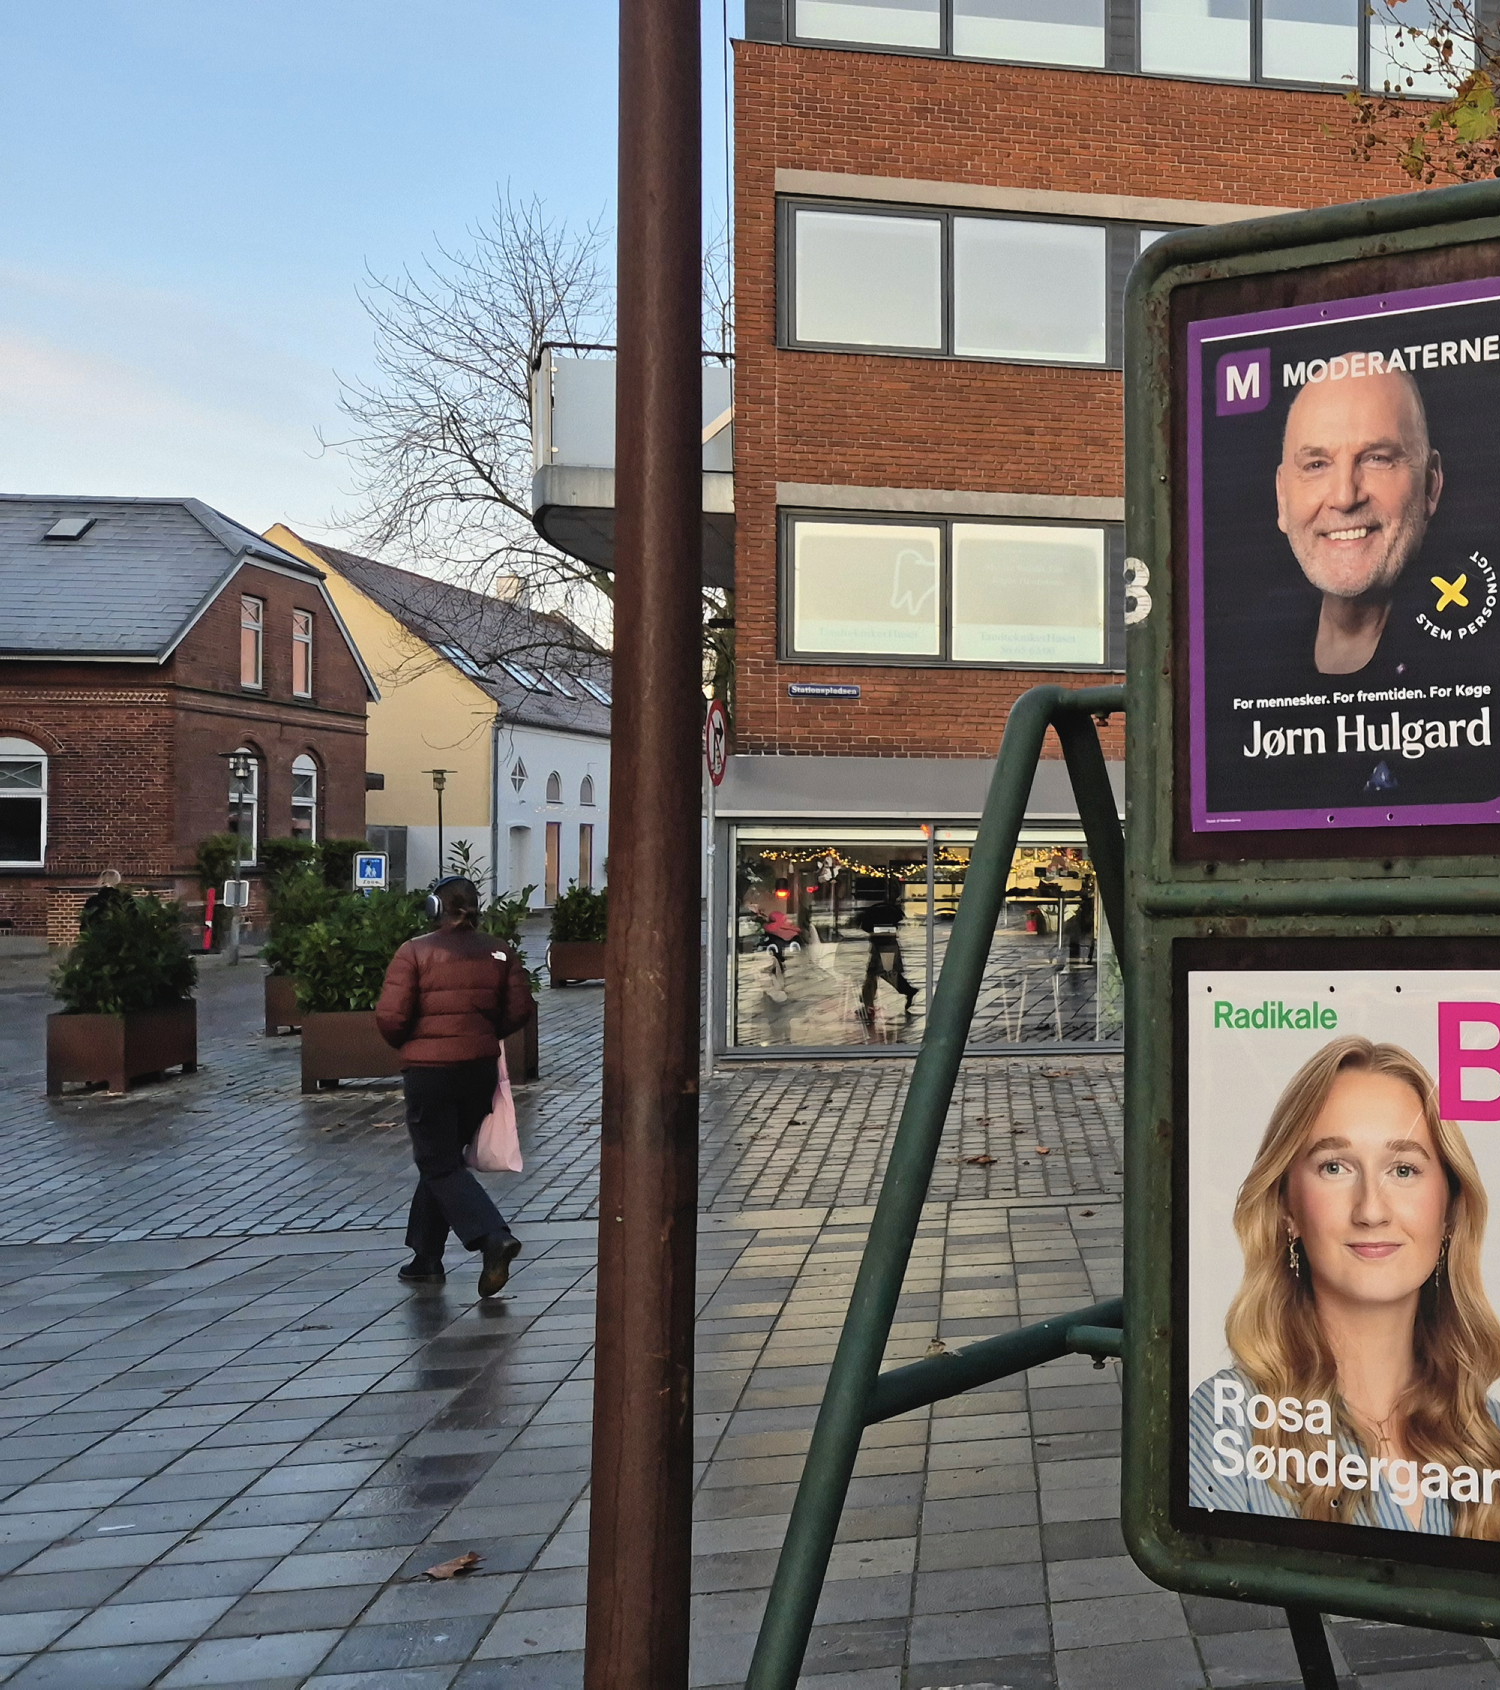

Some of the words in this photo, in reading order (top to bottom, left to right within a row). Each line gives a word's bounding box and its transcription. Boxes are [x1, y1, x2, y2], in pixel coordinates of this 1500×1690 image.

[1226, 362, 1260, 402] M
[1283, 335, 1500, 388] MODERATERNE
[1415, 613, 1453, 641] STEM
[1457, 550, 1498, 640] PERSONLIGT
[791, 686, 857, 696] Stationspladsen
[1233, 698, 1254, 710] For
[1256, 694, 1331, 709] mennesker.
[1333, 692, 1356, 704] For
[1357, 687, 1427, 702] fremtiden.
[1429, 685, 1453, 698] For
[1455, 684, 1492, 698] Køge
[1243, 720, 1327, 759] Jørn
[1336, 706, 1492, 759] Hulgard
[1213, 1001, 1338, 1029] Radikale
[1214, 1379, 1333, 1435] Rosa
